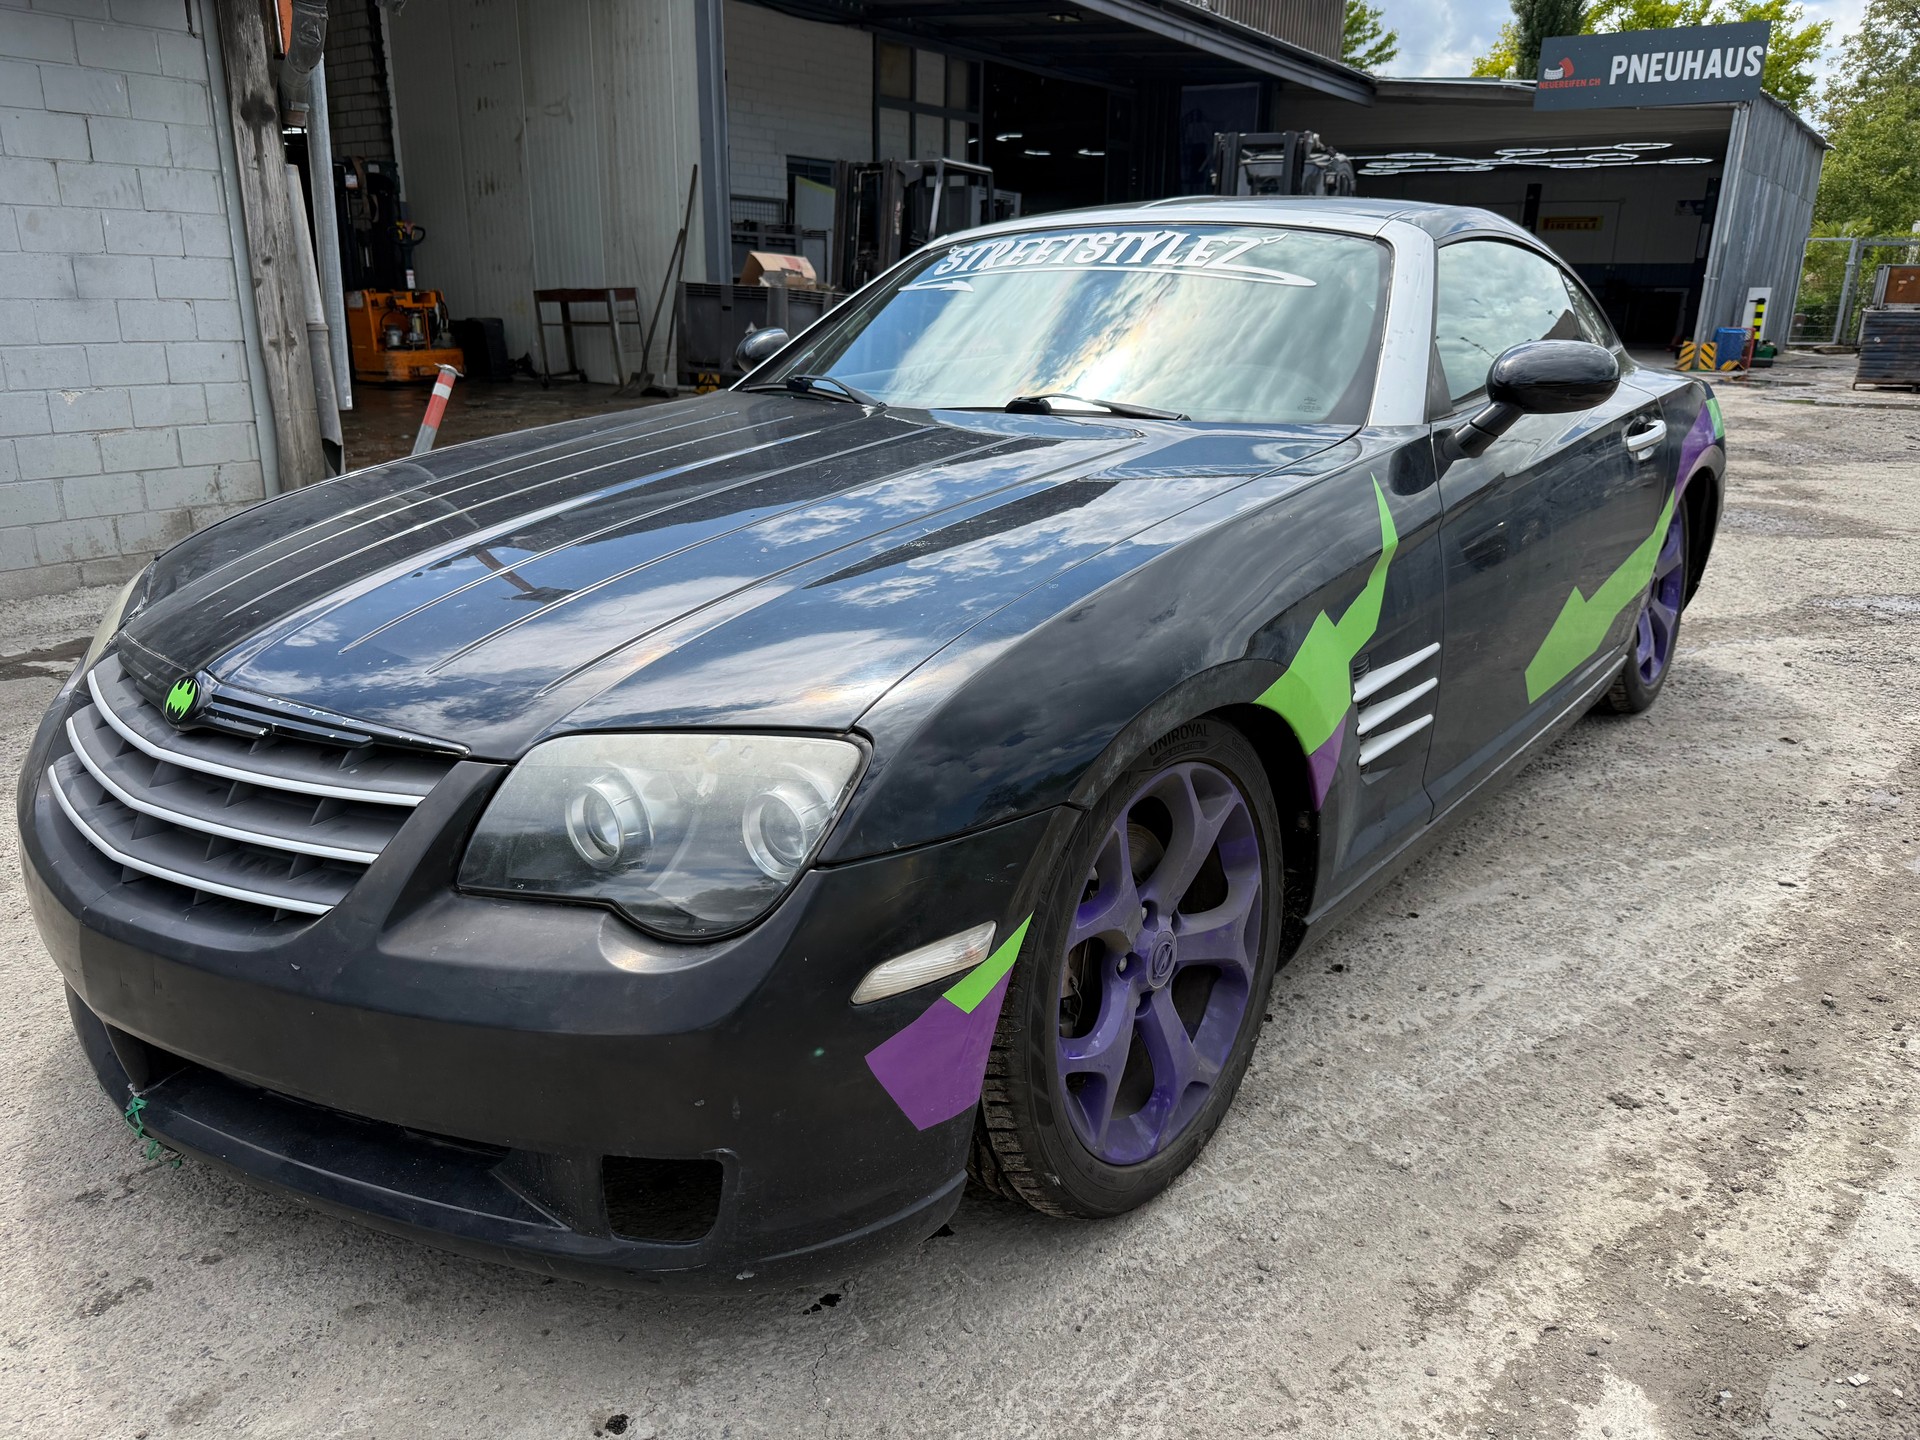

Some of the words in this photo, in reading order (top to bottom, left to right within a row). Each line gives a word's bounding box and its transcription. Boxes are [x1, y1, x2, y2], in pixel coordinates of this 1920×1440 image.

[1609, 45, 1763, 85] PNEUHAUS
[1543, 217, 1599, 230] PIRELLI
[932, 230, 1290, 277] STREETSTYLEZ
[1149, 723, 1210, 757] UNIROYAL
